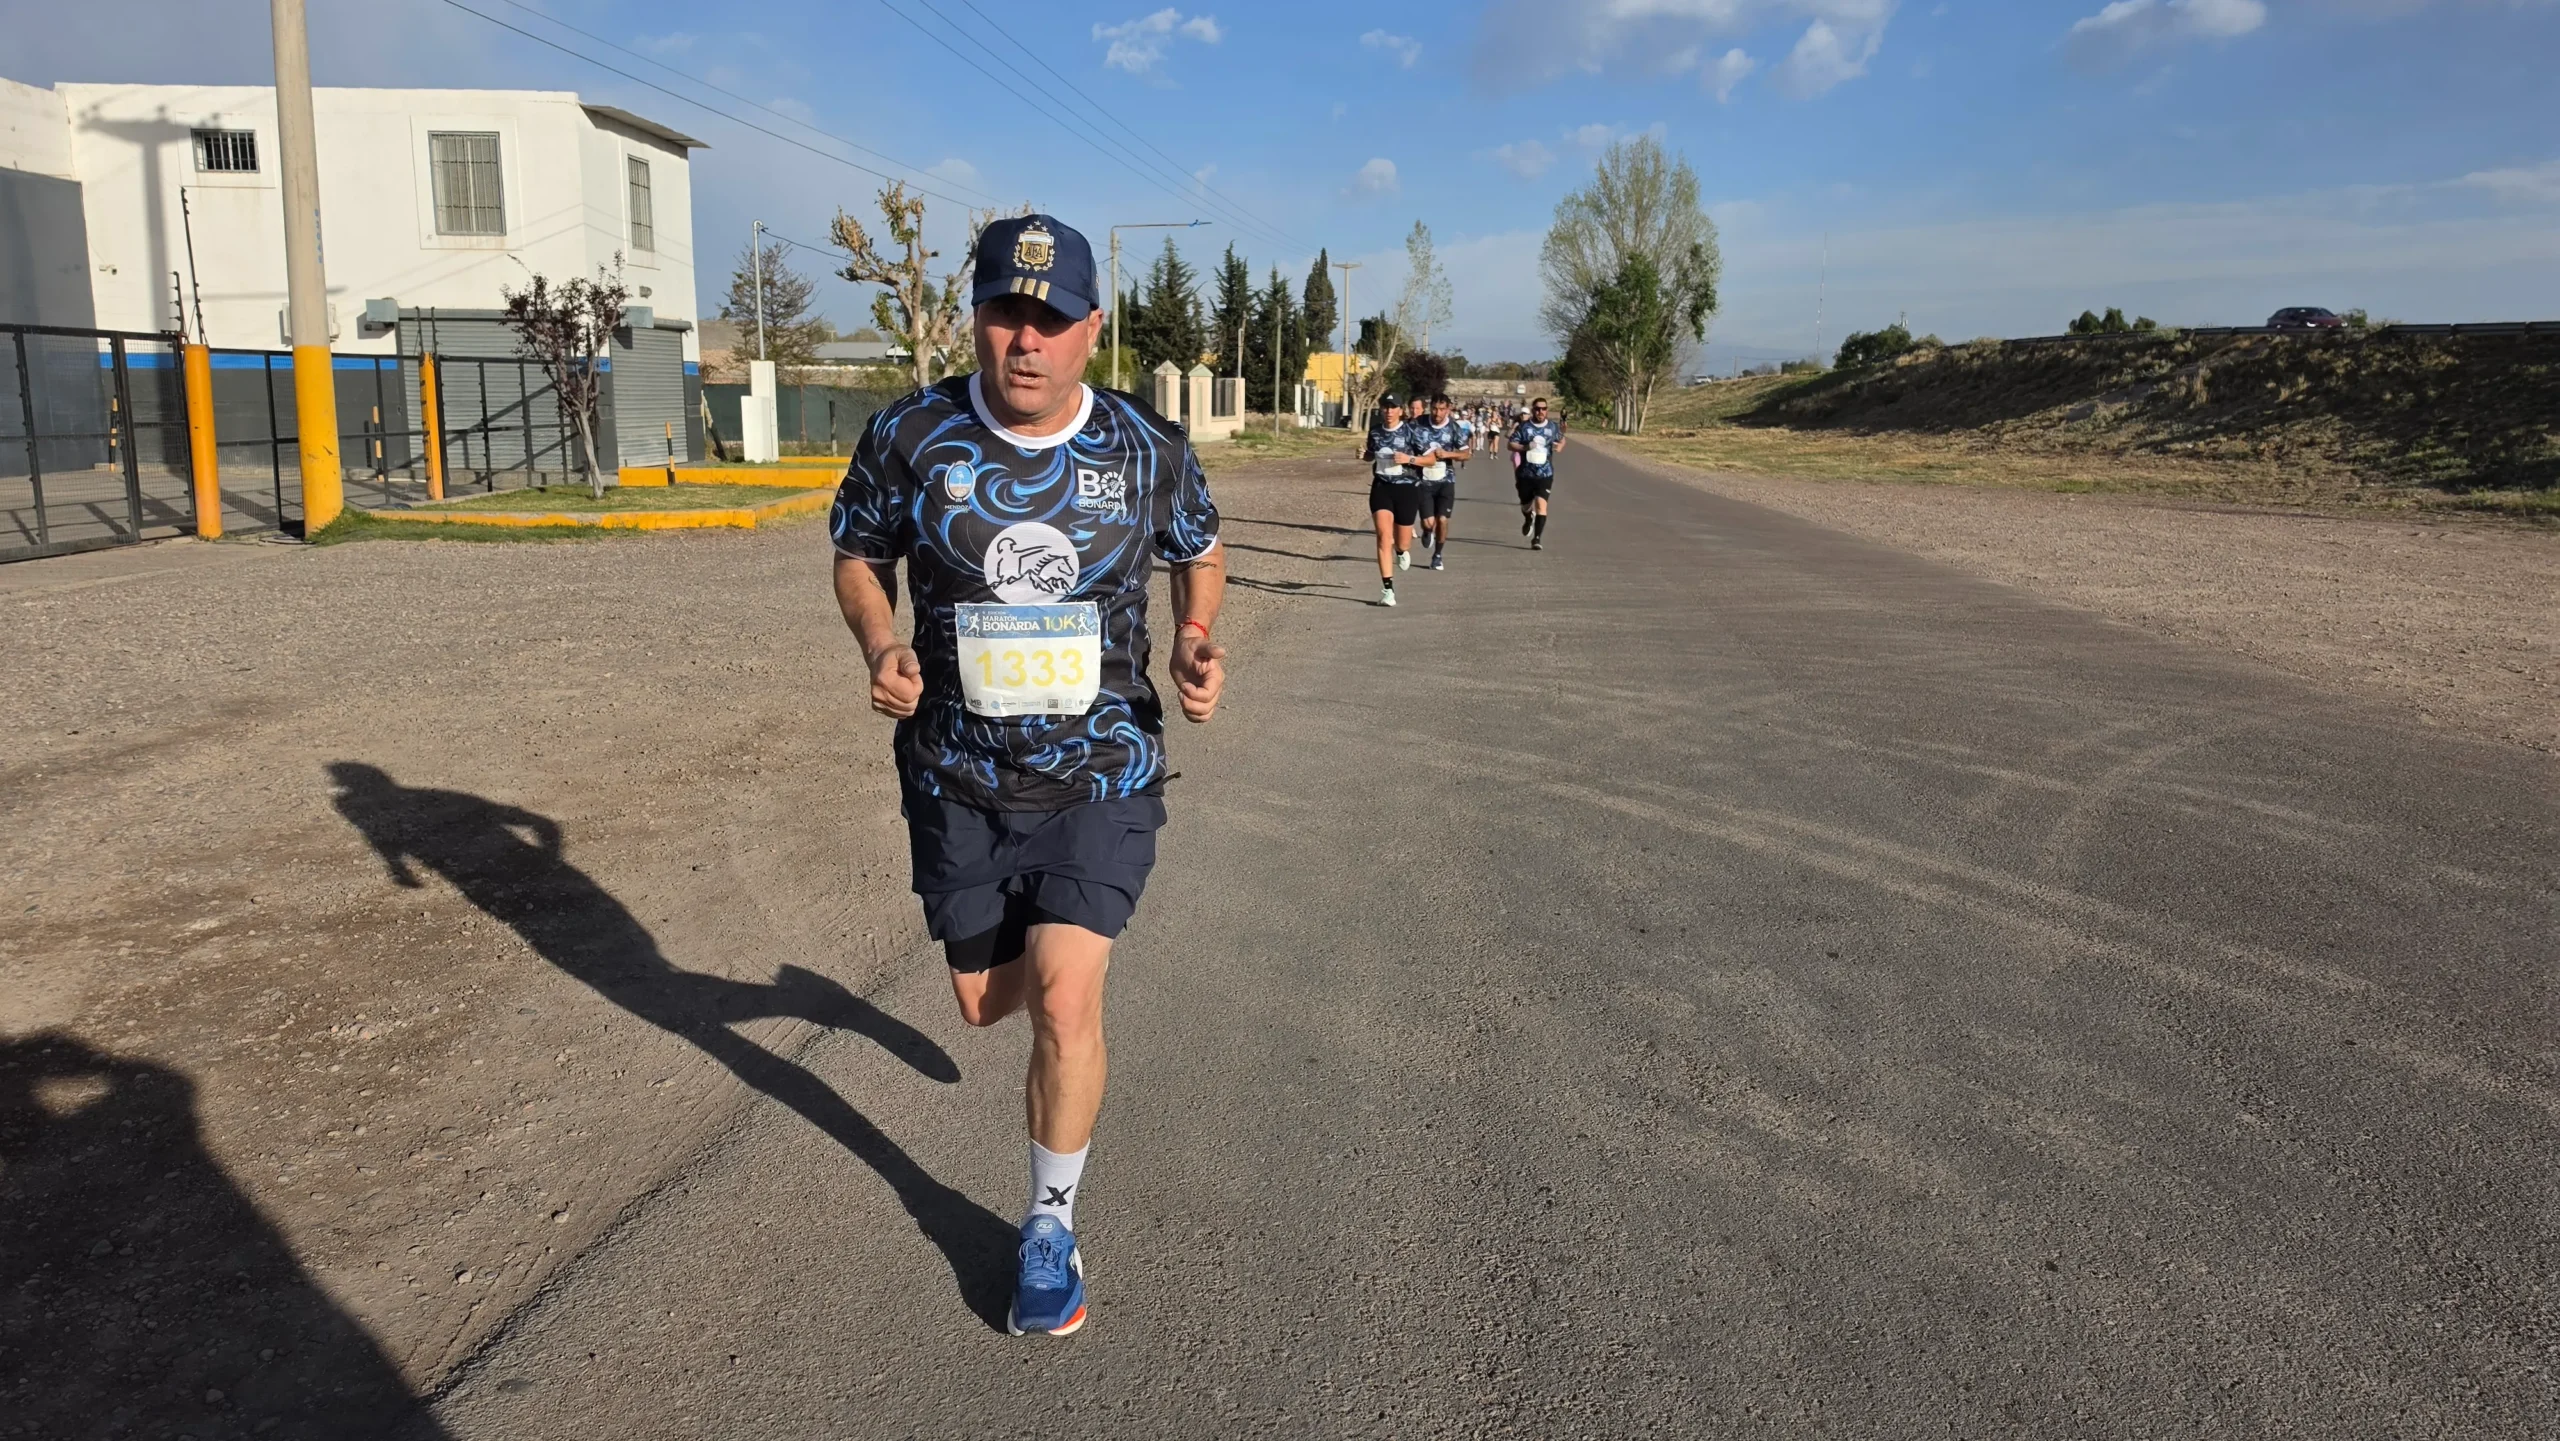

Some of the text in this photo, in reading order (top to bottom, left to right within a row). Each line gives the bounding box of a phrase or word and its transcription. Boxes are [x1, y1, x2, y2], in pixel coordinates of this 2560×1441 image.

[1078, 498, 1127, 511] BONARDA
[982, 614, 1018, 622] MARATÓN
[982, 614, 1076, 632] BONARDA 10K
[975, 648, 1085, 688] 1333
